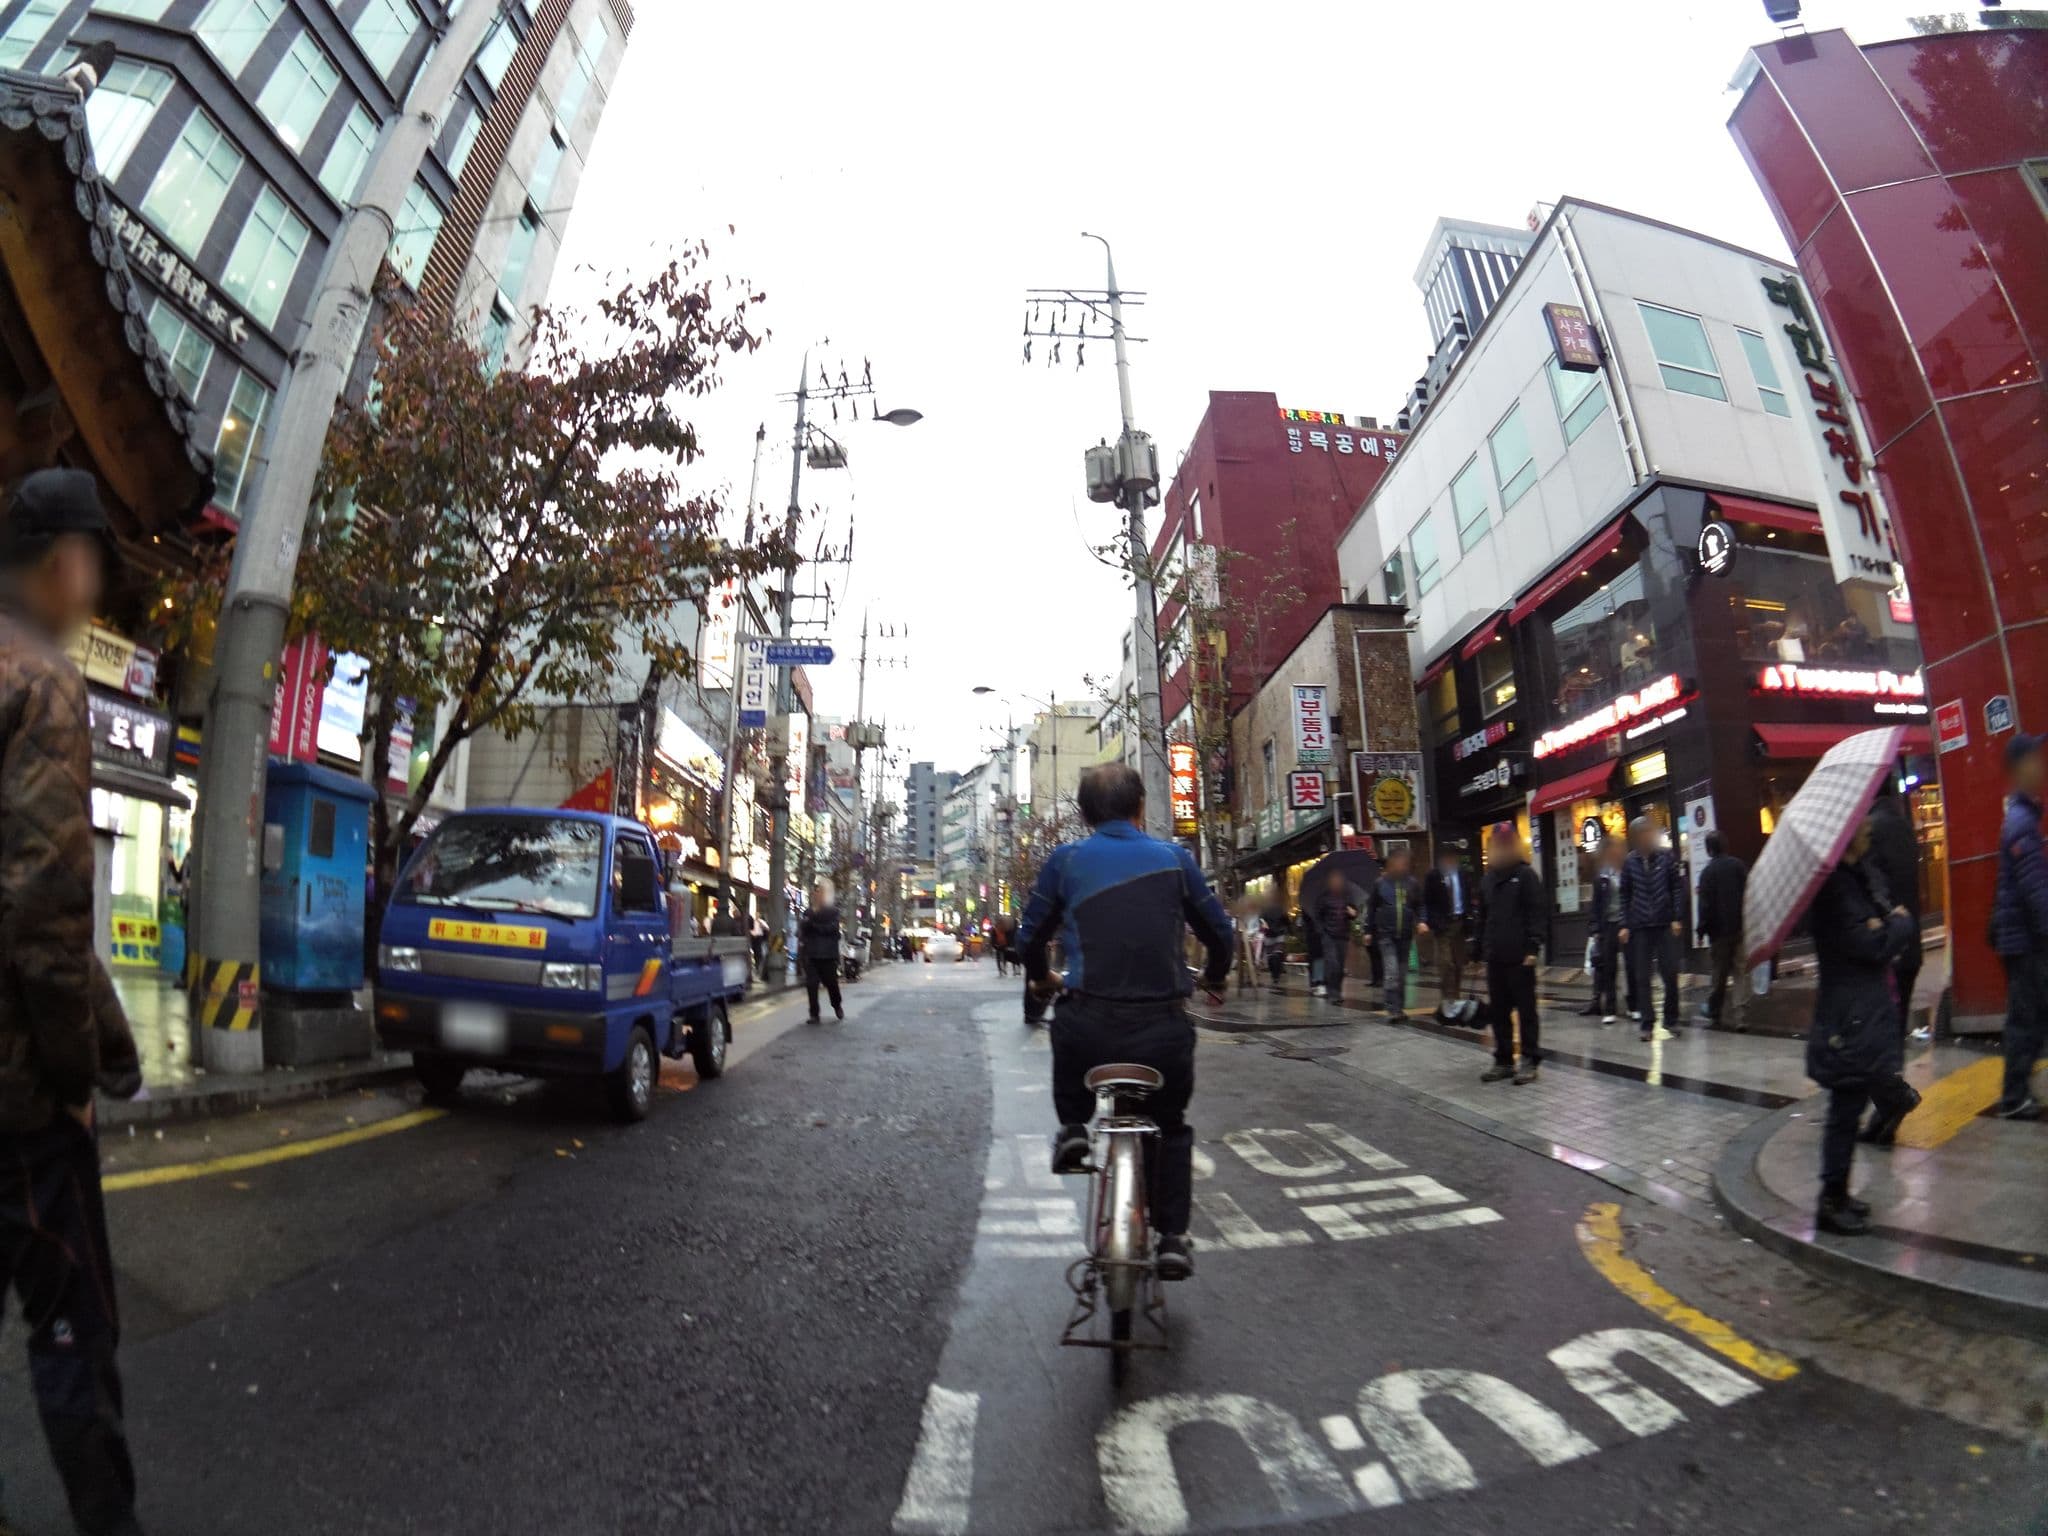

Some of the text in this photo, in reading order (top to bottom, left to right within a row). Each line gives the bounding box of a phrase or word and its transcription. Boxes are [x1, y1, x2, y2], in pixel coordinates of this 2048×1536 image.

[1760, 270, 1883, 546] 대한보청기
[1308, 430, 1379, 457] 목공예
[744, 636, 766, 708] 아코디언
[299, 681, 316, 753] COFFEE
[1300, 700, 1325, 749] 부동산
[1295, 775, 1321, 804] 꽃
